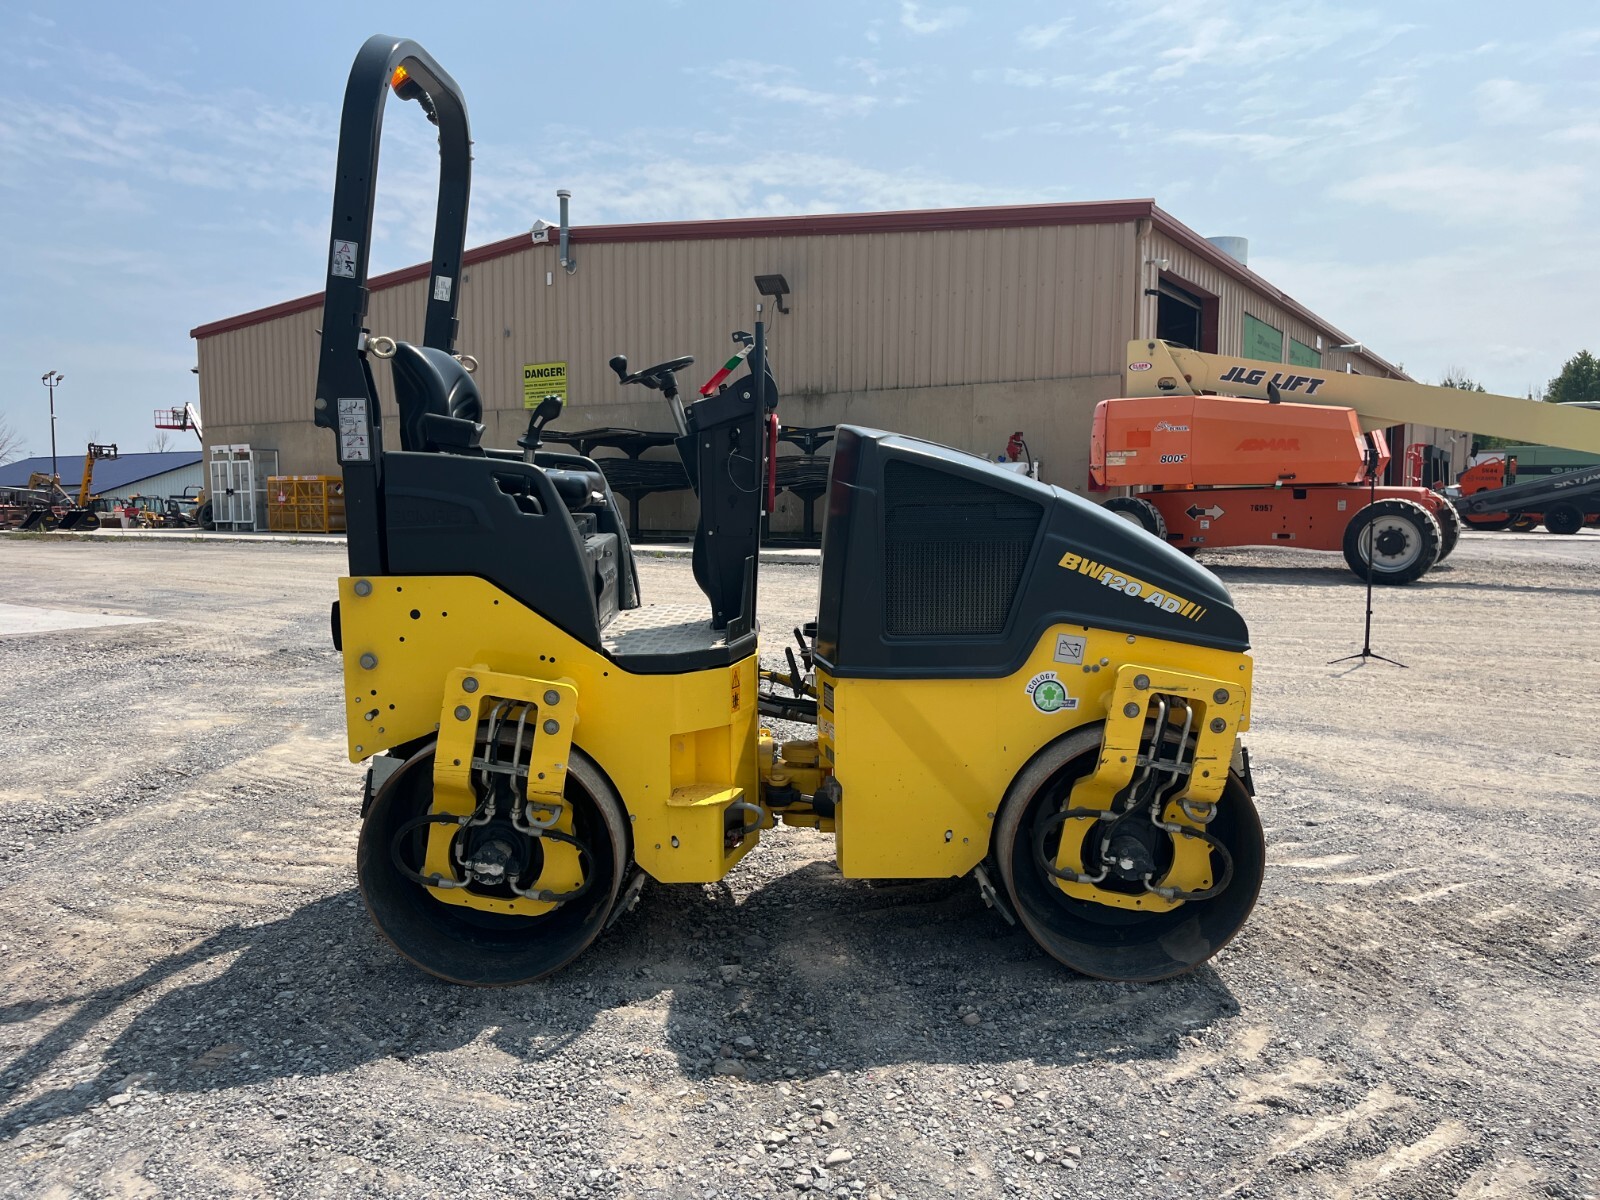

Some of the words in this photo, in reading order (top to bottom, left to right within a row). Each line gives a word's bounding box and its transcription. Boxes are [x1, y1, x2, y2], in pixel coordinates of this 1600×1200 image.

[525, 367, 565, 379] DANGER!
[1220, 366, 1266, 385] JLG
[1269, 372, 1326, 395] LIFT
[1143, 591, 1182, 614] AD
[1026, 673, 1056, 694] ECOLOGY
